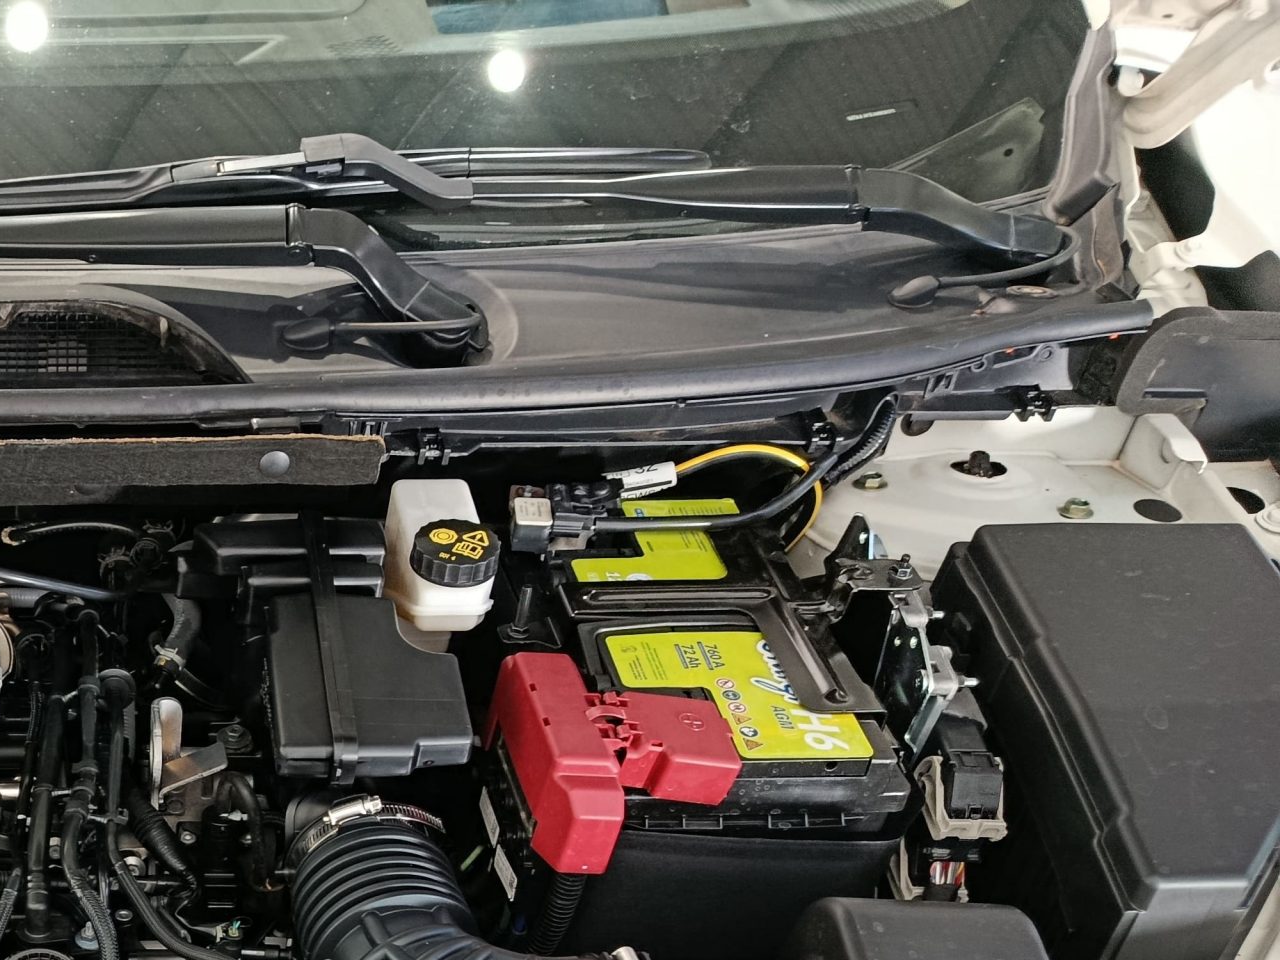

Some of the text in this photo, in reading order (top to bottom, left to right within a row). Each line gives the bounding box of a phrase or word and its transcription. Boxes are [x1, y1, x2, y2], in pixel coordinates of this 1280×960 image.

[681, 645, 701, 668] 72 Ah
[705, 644, 722, 660] 760
[771, 705, 795, 730] AGM
[790, 709, 850, 751] H6
